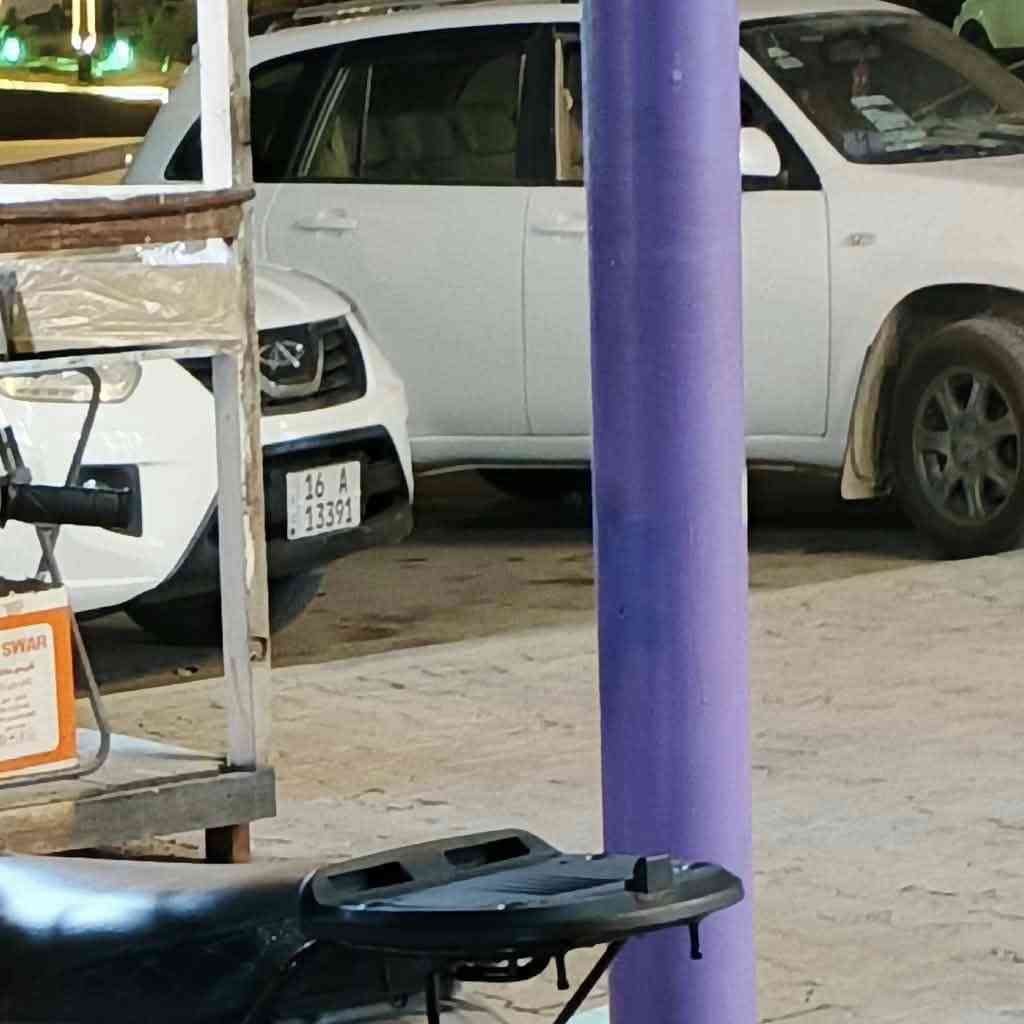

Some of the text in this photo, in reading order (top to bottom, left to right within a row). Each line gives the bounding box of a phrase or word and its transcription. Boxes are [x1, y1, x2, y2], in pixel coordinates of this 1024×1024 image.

[305, 466, 349, 500] 16 A
[305, 497, 353, 532] 13391
